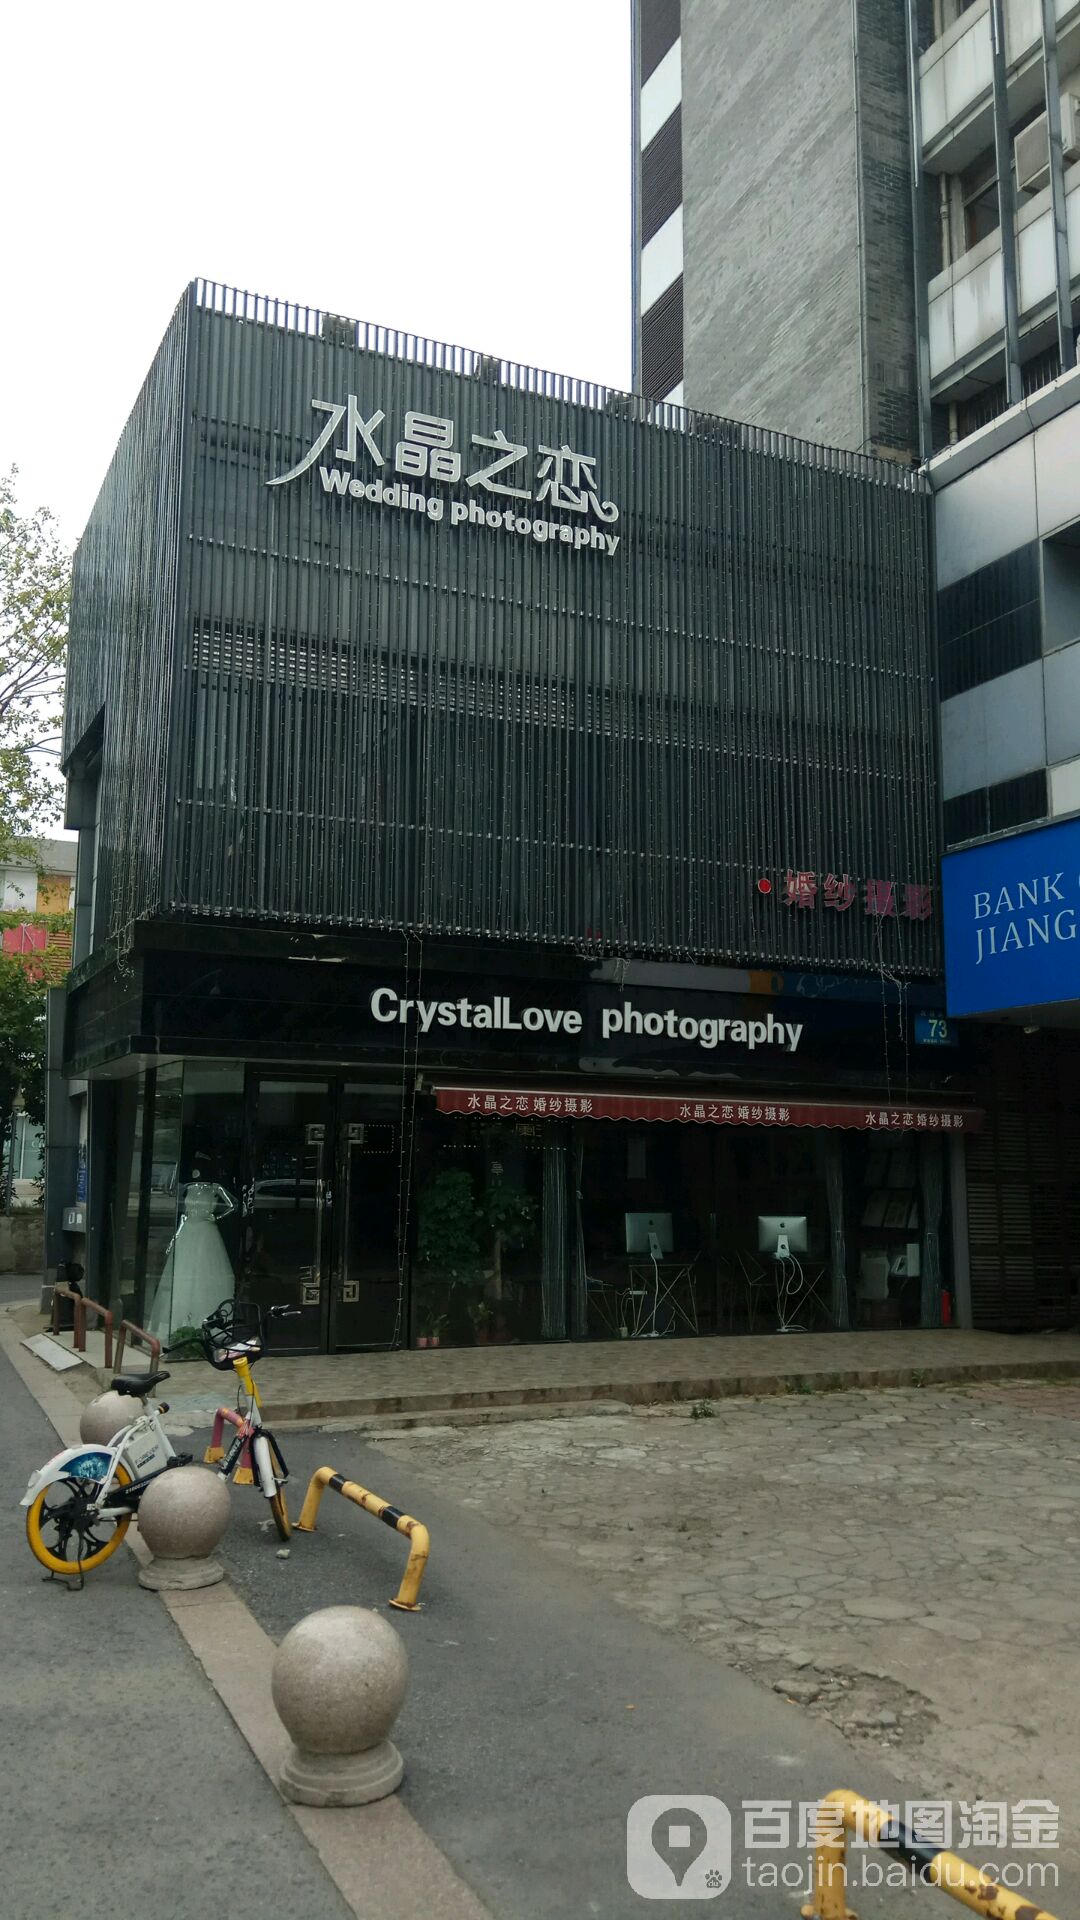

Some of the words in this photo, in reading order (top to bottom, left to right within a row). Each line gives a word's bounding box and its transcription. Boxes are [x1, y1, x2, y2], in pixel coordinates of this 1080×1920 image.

[265, 394, 619, 522] 水晶之恋
[319, 466, 444, 521] Wedding
[451, 498, 621, 556] photography
[973, 872, 1065, 920] BANK
[975, 909, 1077, 965] JIANG
[370, 987, 582, 1033] CrystalLove
[602, 1001, 803, 1052] photography
[928, 1018, 947, 1038] 73
